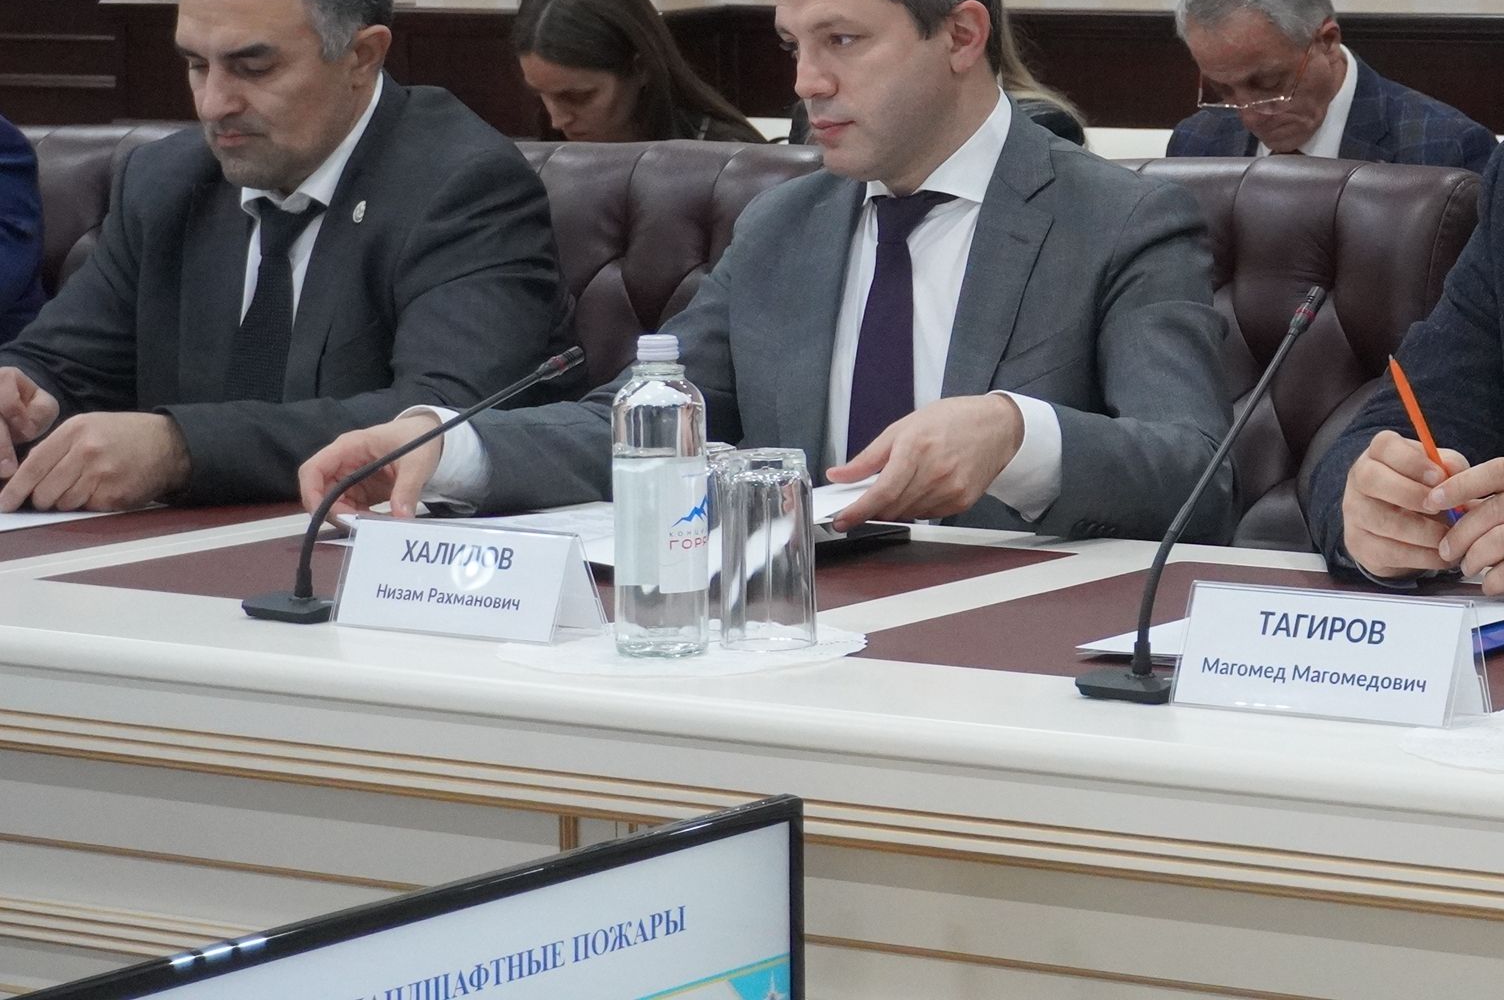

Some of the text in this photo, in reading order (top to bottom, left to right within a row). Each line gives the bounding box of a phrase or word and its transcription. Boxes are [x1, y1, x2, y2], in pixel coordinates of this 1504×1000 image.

[401, 539, 514, 570] ХАЛИЛОВ
[376, 583, 520, 611] Низам Рахманович
[1260, 610, 1386, 645] ТАГИРОВ
[1201, 657, 1427, 693] Магомед Магомедович
[571, 905, 687, 964] ПОЖАРЫ
